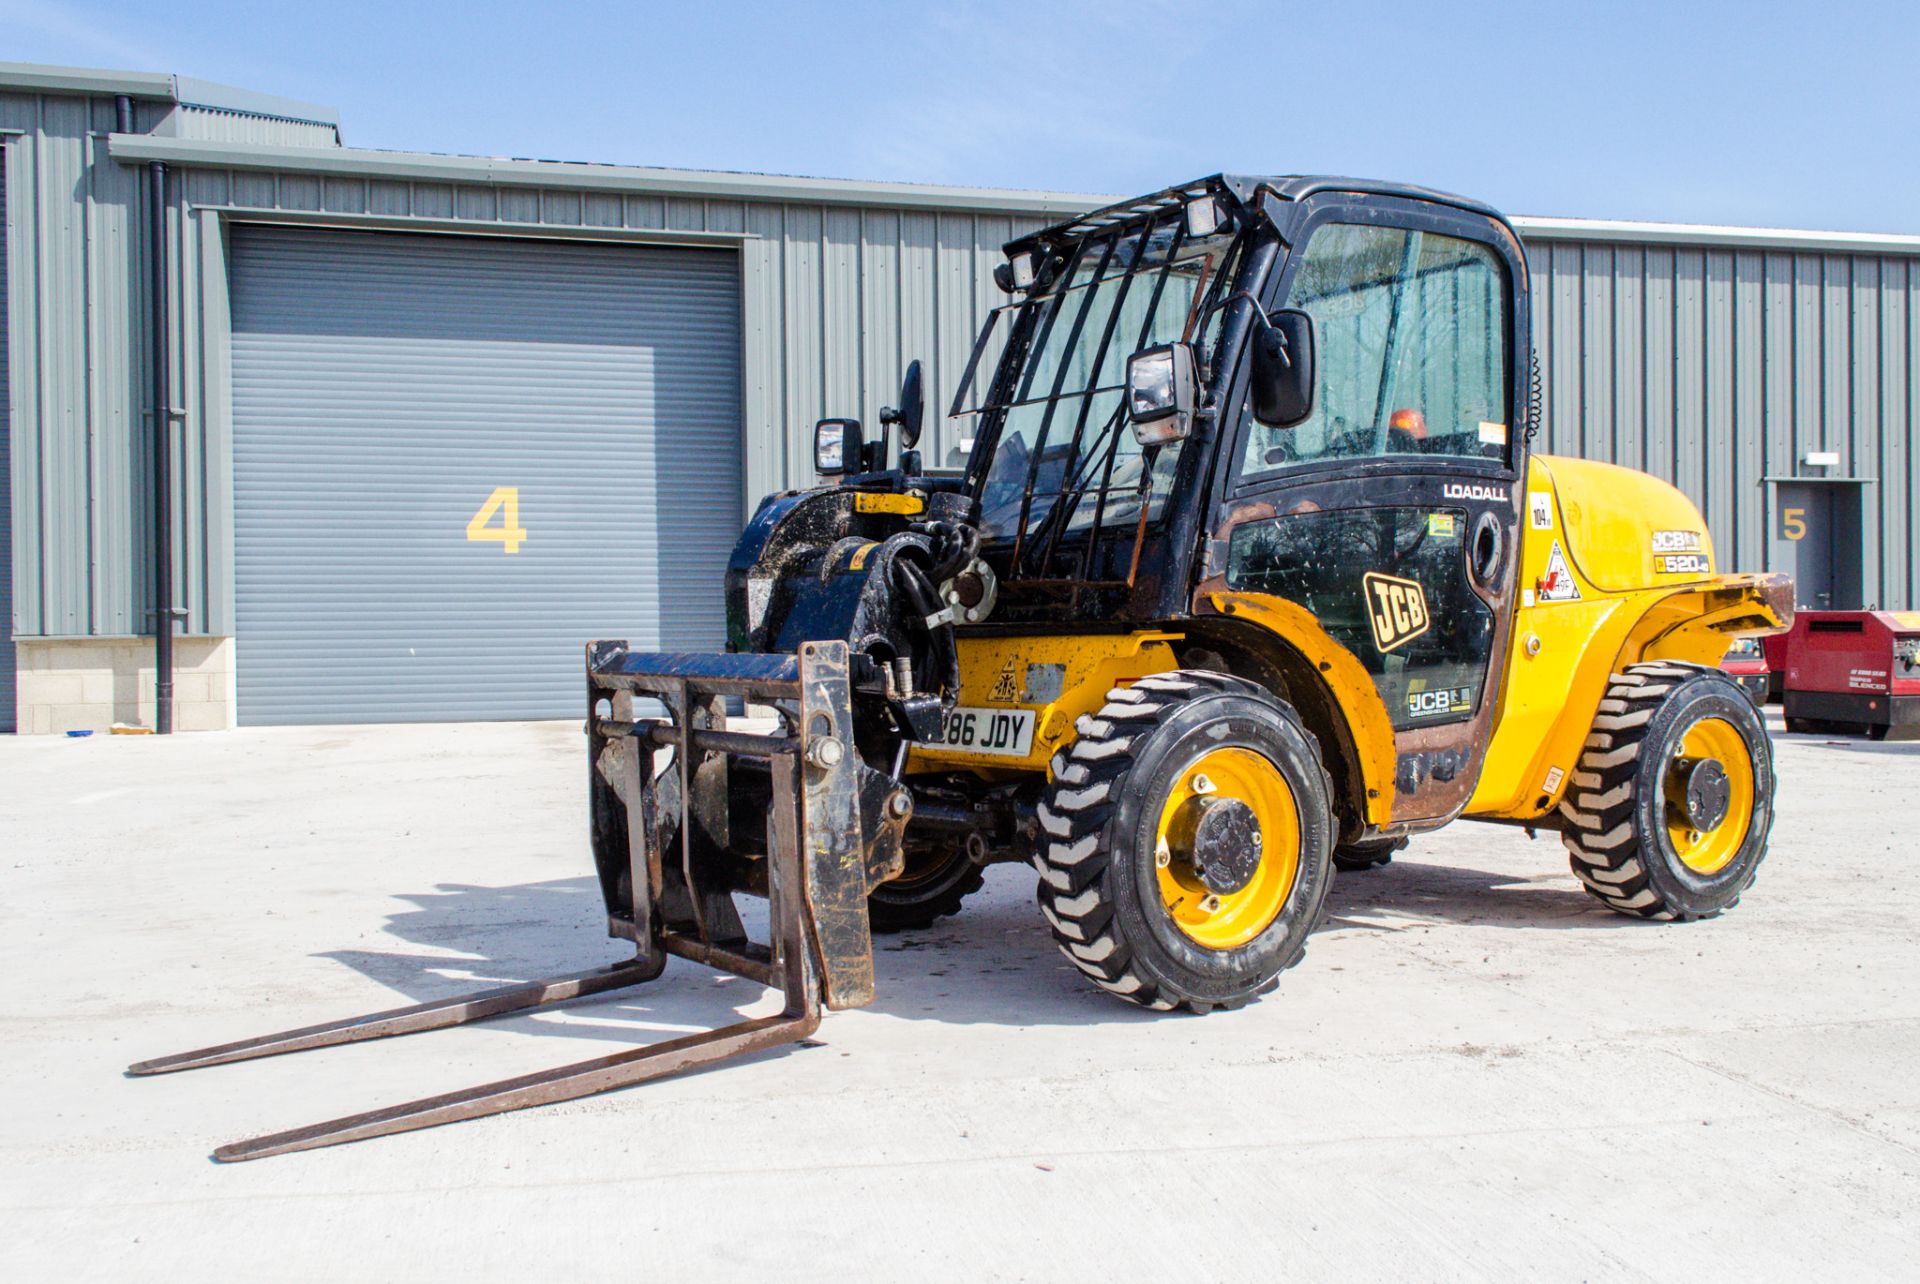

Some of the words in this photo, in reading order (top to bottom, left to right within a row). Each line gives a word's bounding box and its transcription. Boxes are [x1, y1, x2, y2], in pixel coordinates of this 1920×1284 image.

[1443, 484, 1508, 503] LOADALL
[466, 487, 527, 554] 4
[1533, 509, 1546, 526] 104
[1783, 508, 1807, 541] 5
[1652, 531, 1685, 547] JCB
[1372, 580, 1425, 644] JCB
[1409, 691, 1450, 712] JCB
[943, 713, 976, 746] 86
[980, 714, 1025, 749] JDY
